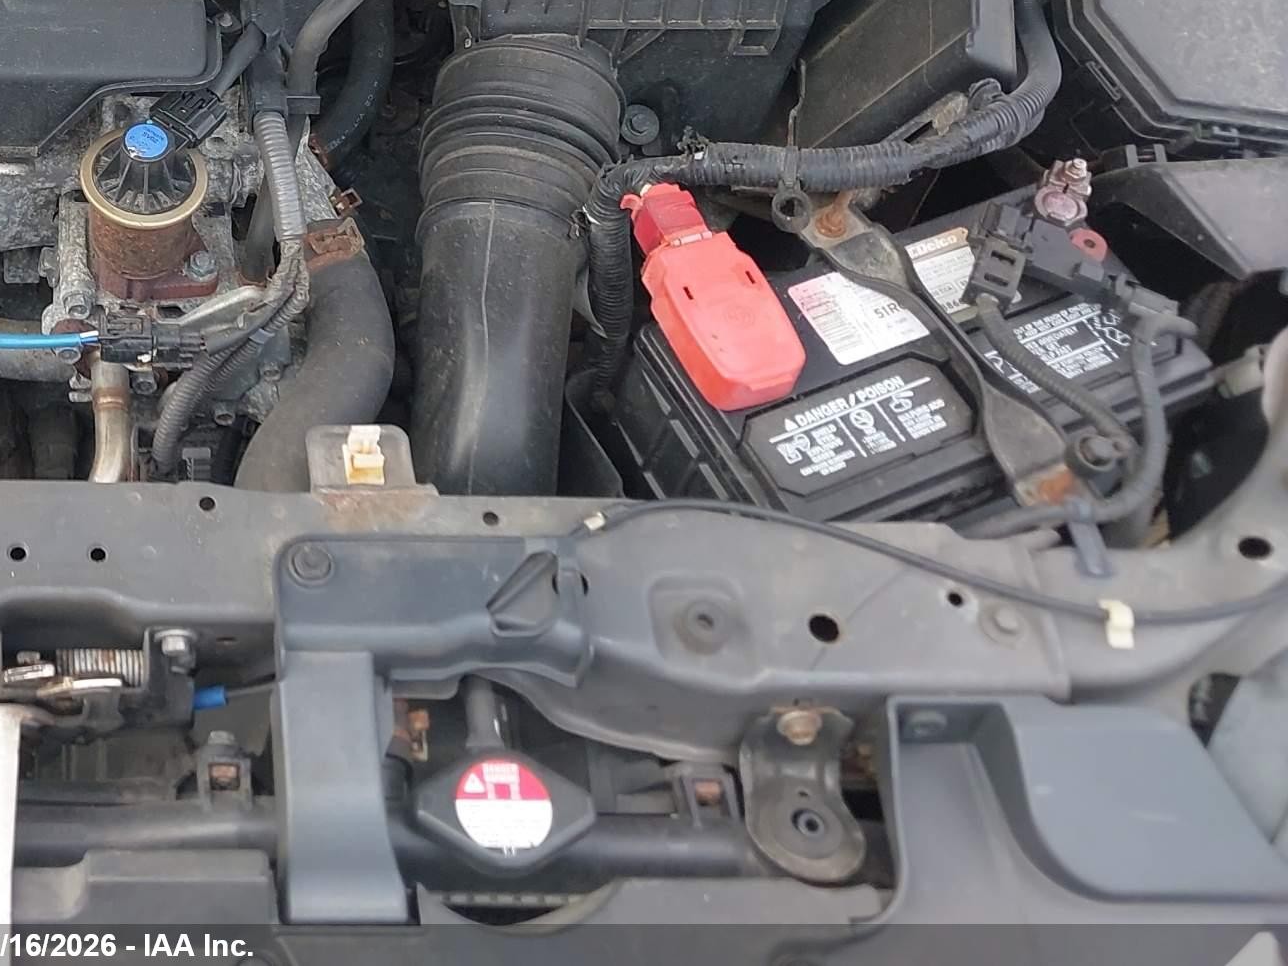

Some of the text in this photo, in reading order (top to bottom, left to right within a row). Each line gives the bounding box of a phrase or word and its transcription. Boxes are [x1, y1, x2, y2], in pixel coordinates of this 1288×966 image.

[874, 301, 901, 319] 51R
[795, 397, 849, 427] DANGER
[855, 375, 904, 402] POISON
